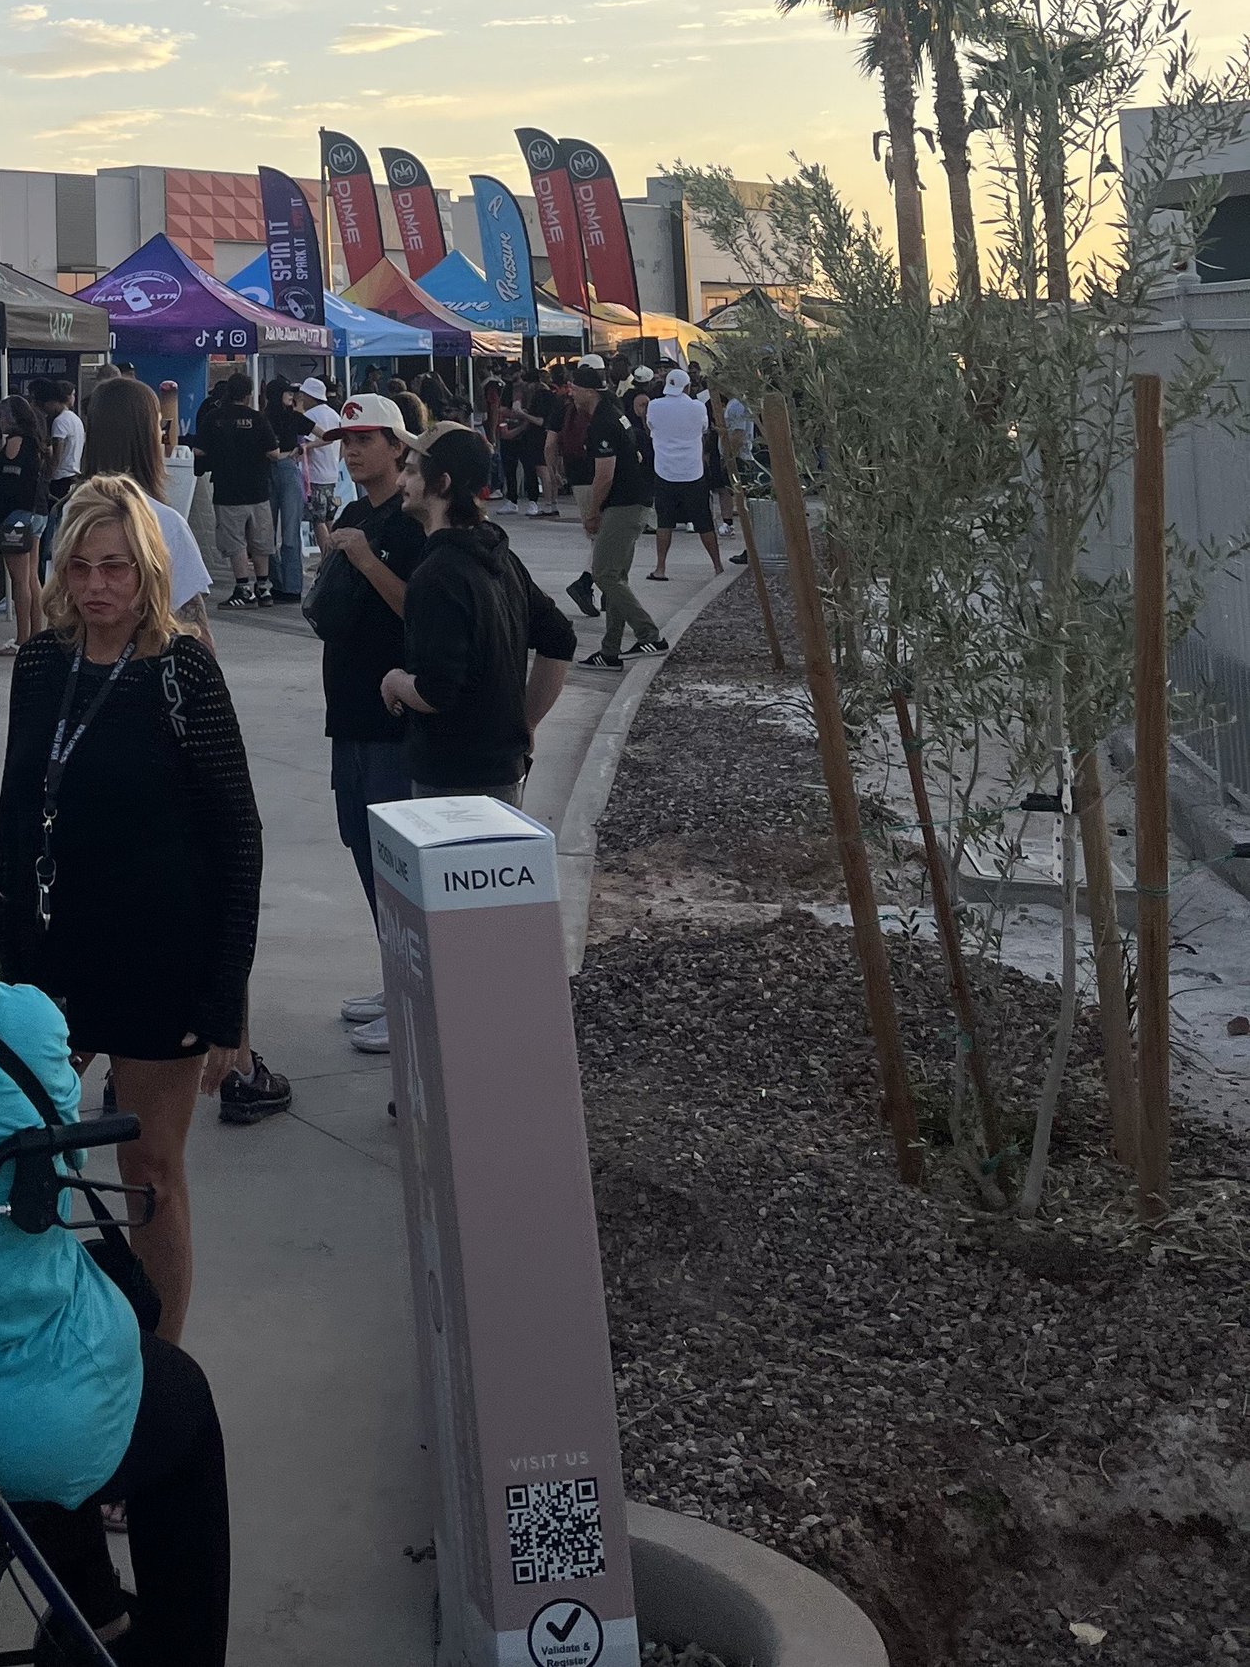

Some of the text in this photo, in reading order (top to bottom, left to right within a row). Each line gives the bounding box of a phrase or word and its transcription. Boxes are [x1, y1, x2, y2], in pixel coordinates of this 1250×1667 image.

[337, 181, 360, 244] DIME
[397, 193, 423, 251] DIME
[538, 177, 564, 243] DIME
[578, 185, 605, 246] DIME
[269, 220, 293, 281] SPIN IT
[294, 238, 308, 280] SPARK IT
[496, 232, 522, 302] Pressure
[94, 293, 178, 303] FLKR LYTR
[444, 866, 536, 892] INDICA
[510, 1451, 590, 1472] VISIT US
[541, 1642, 591, 1655] Validate &
[546, 1657, 588, 1667] Register
